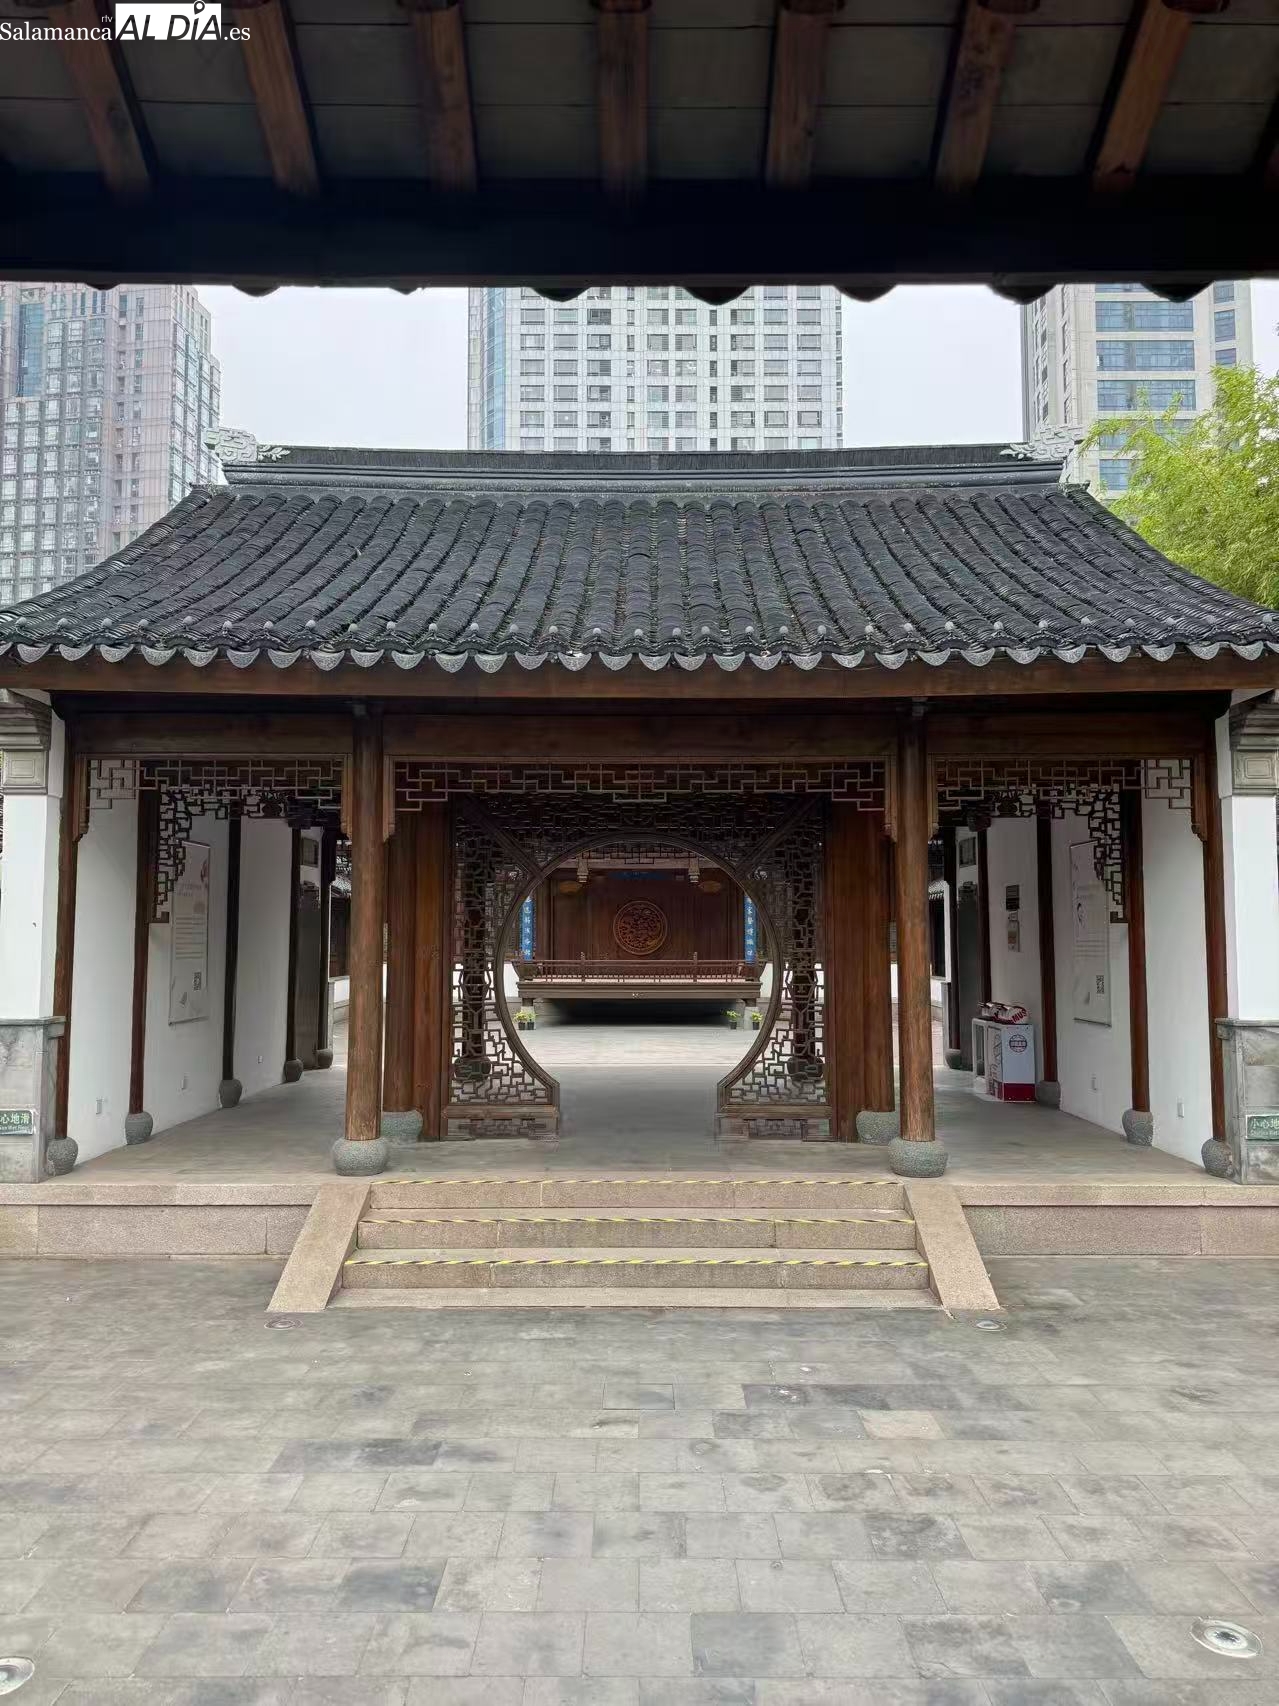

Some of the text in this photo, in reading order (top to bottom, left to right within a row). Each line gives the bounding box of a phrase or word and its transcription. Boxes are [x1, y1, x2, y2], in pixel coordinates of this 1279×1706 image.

[0, 1112, 30, 1124] 心地滑
[1251, 1118, 1279, 1129] 小心地
